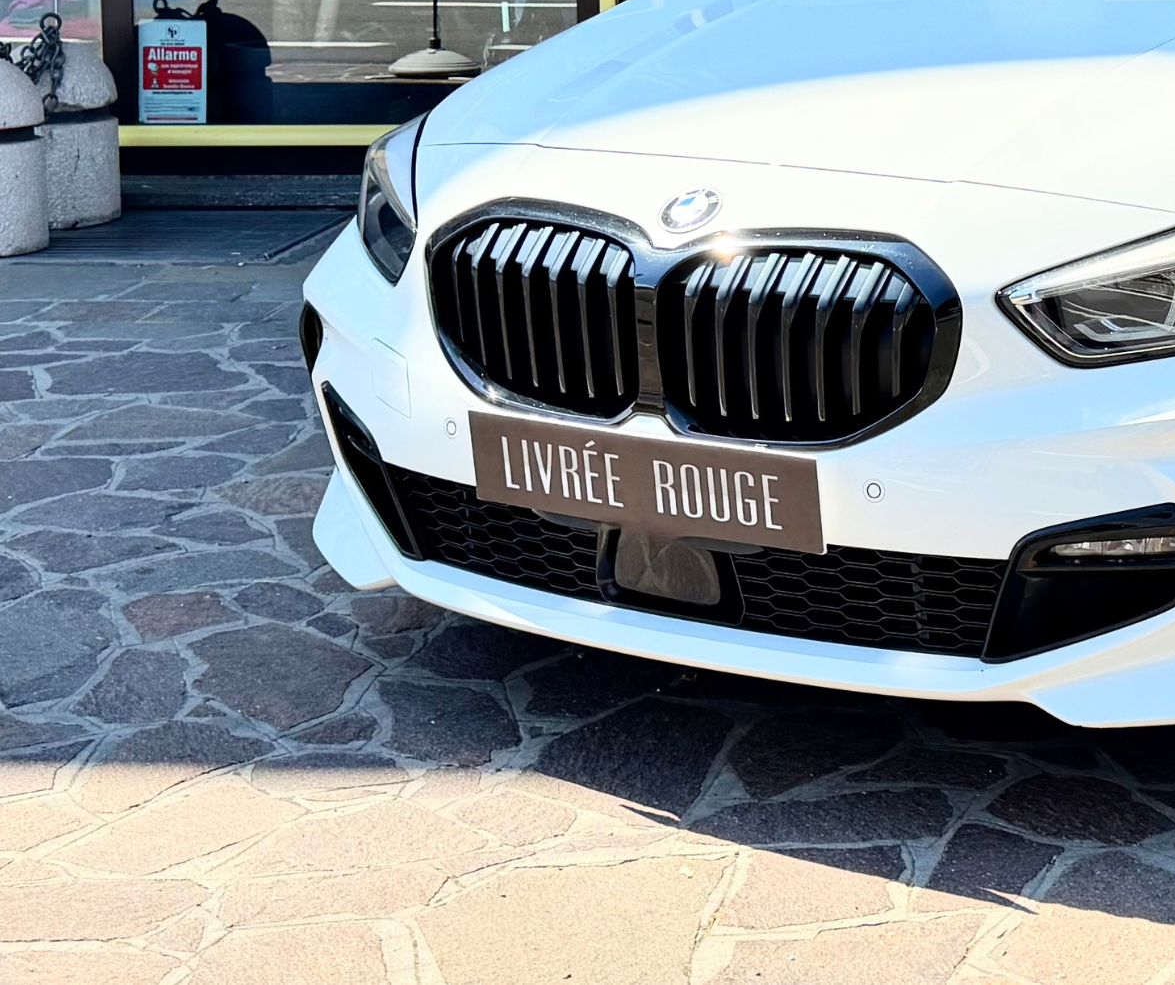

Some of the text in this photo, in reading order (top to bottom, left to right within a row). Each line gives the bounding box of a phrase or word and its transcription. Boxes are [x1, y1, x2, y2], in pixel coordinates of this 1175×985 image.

[147, 48, 198, 61] Allarme
[501, 435, 783, 531] LIVRÉE ROUGE
